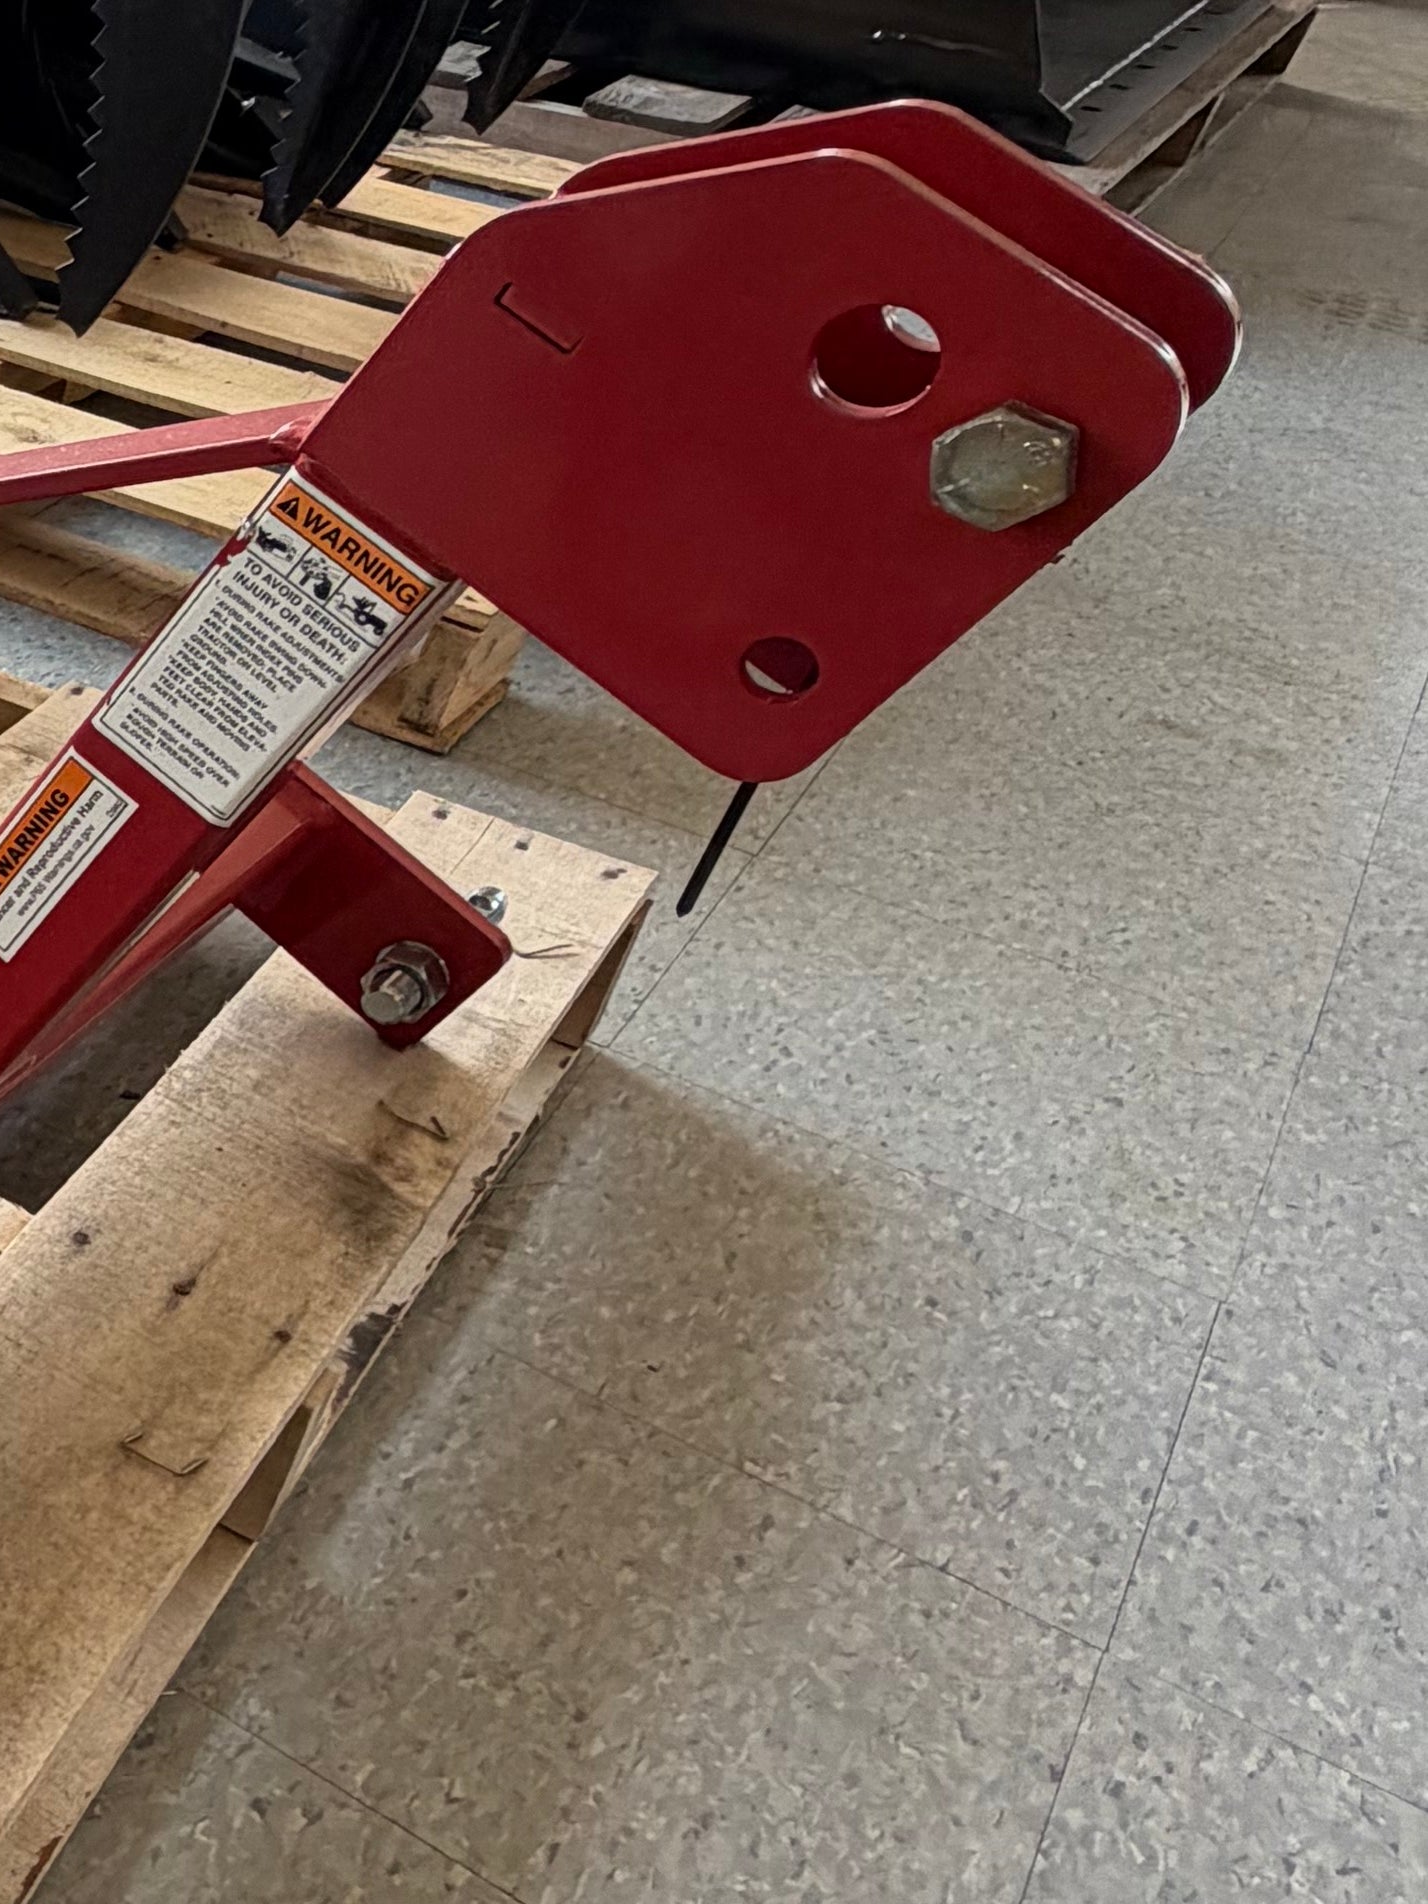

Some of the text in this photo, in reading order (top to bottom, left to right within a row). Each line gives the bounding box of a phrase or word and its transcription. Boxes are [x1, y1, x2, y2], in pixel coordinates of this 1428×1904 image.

[297, 506, 423, 607] WARNING
[231, 570, 280, 611] INJURY
[277, 606, 301, 627] OR
[241, 557, 361, 653] TO AVOID SERIOUS
[253, 610, 281, 634] RAKE
[175, 649, 202, 672] FROM
[195, 624, 238, 660] TRACTOR
[249, 667, 279, 693] LEVEL
[202, 616, 222, 634] ARE
[265, 666, 296, 693] PLACE
[242, 619, 269, 643] RAKE
[204, 659, 243, 691] FINGERS
[241, 688, 268, 711] AWAY
[10, 875, 31, 898] and
[25, 813, 82, 881] Reproductive
[75, 787, 103, 818] Harm
